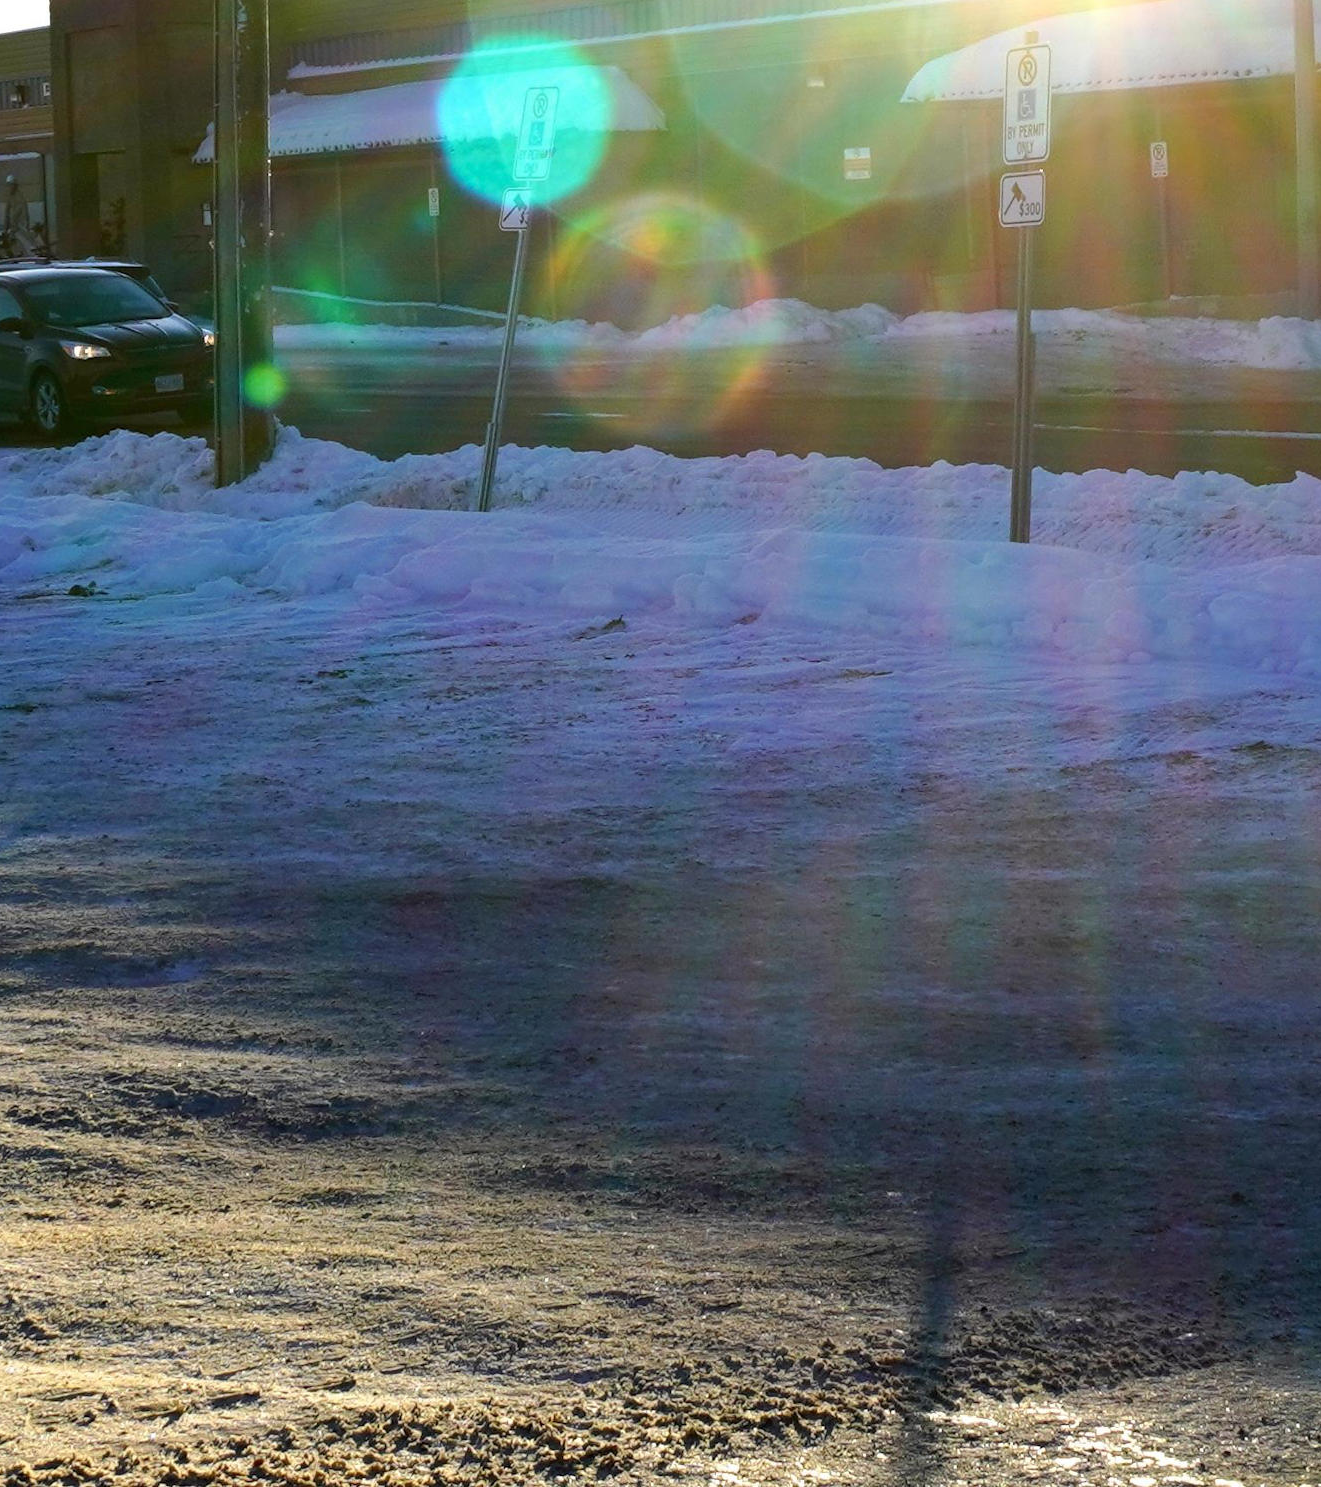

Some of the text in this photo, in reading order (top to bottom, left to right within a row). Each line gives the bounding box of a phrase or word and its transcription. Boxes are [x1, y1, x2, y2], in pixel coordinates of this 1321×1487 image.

[1007, 122, 1045, 140] BY PERMIT
[1017, 141, 1034, 155] ONLY
[1019, 201, 1041, 218] $300
